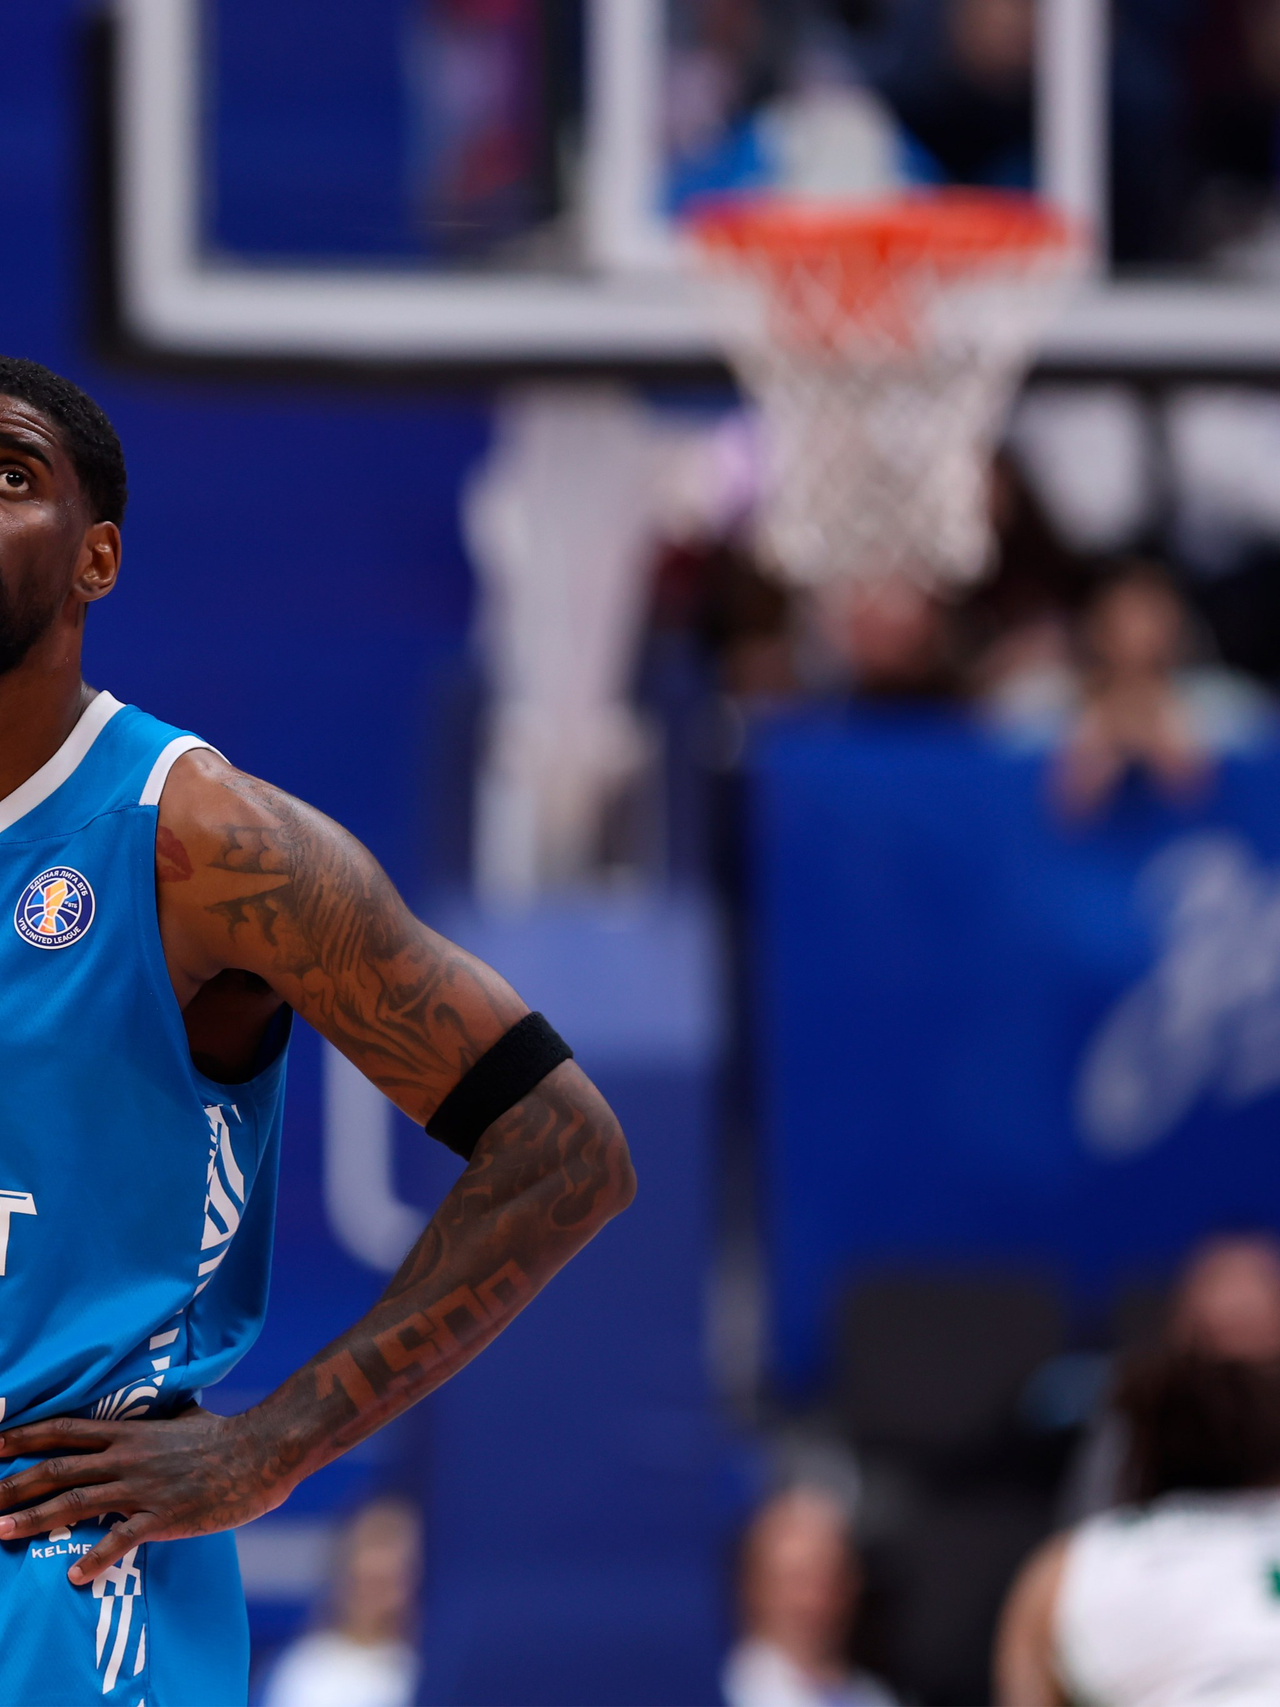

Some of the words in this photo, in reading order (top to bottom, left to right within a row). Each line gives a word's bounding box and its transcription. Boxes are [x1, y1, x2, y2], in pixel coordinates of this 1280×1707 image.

[30, 870, 60, 890] ЕДИНАЯ
[59, 870, 79, 884] ЛИГА
[77, 880, 88, 897] ВТБ
[18, 917, 28, 931] VTB
[25, 928, 53, 944] UNITED
[53, 926, 82, 944] LEAGUE
[31, 1543, 93, 1559] KELME
